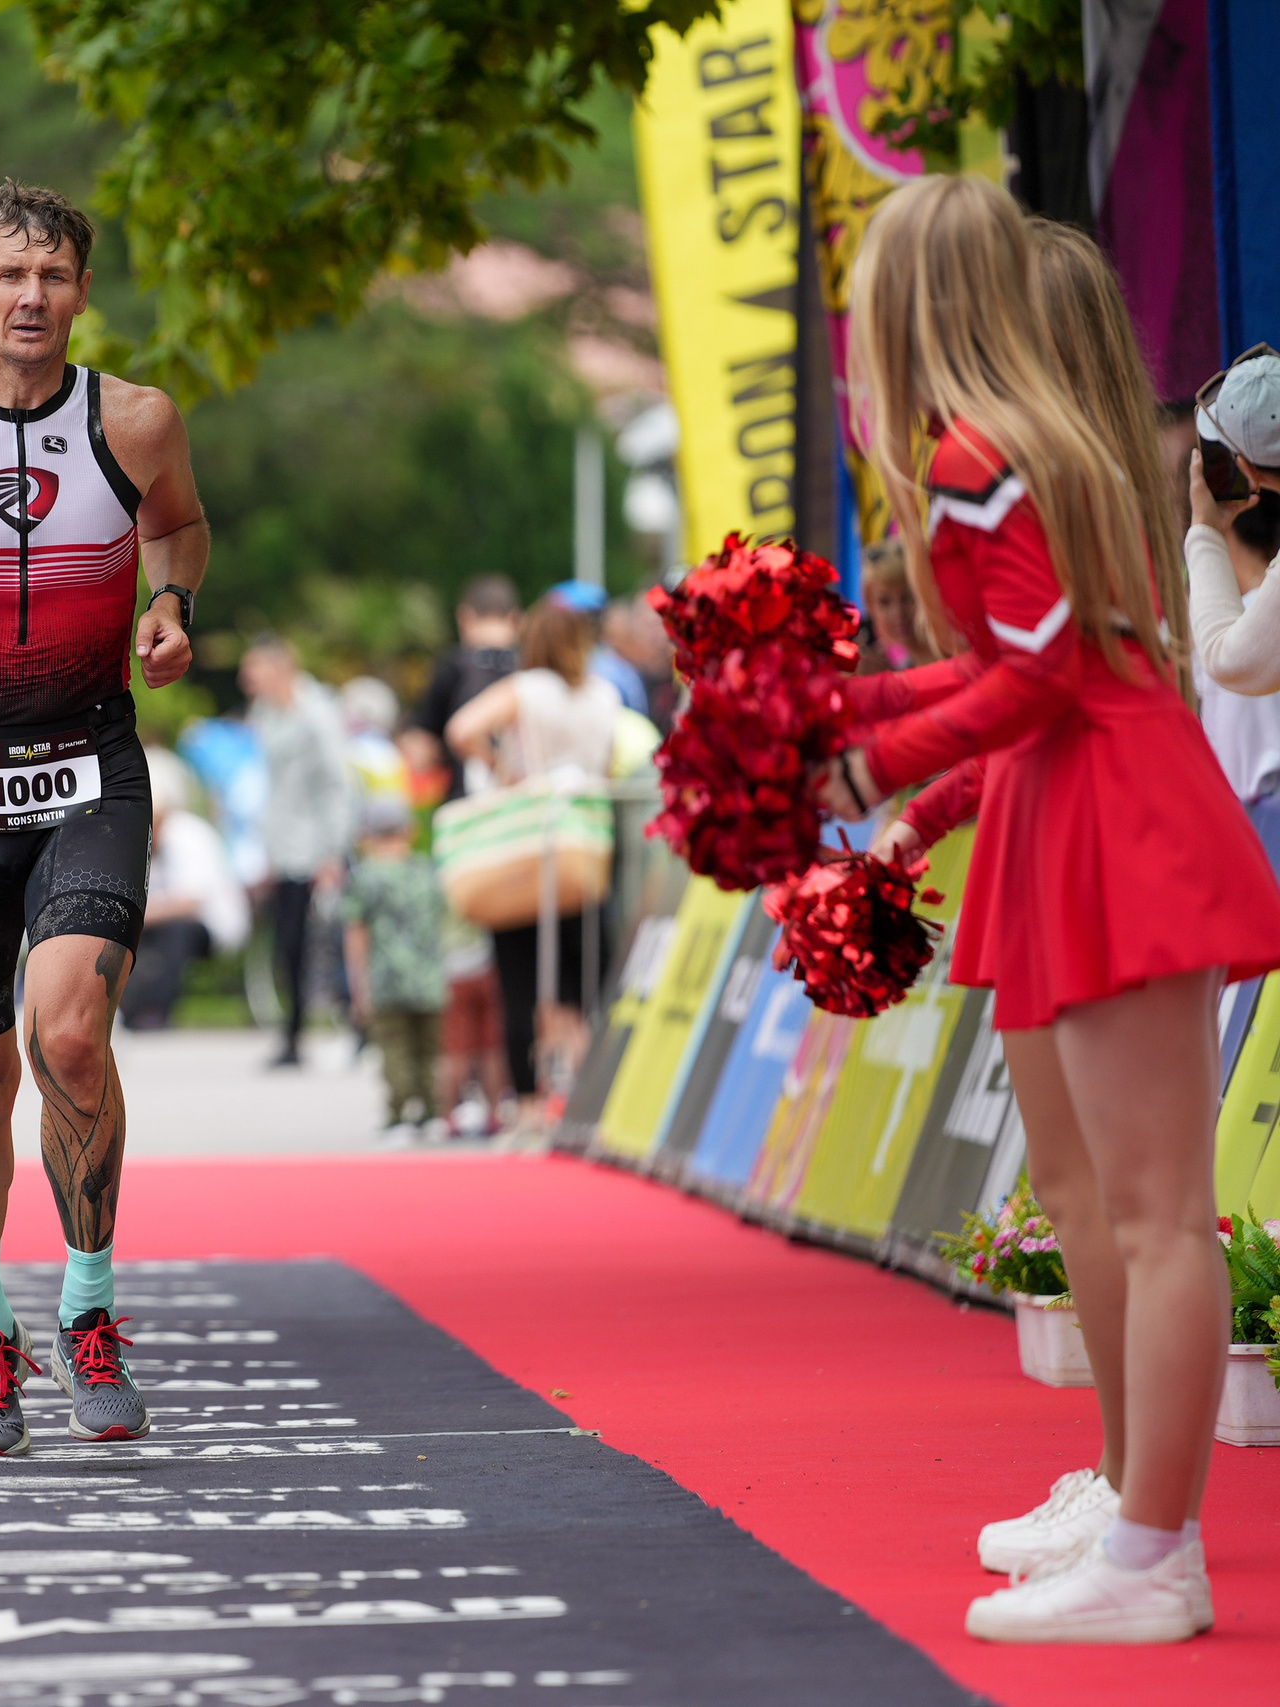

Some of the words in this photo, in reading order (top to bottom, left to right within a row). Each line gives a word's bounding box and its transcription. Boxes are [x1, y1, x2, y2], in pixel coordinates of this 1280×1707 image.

[697, 33, 788, 244] STAR
[8, 746, 26, 755] IRON
[33, 742, 51, 753] STAR
[65, 739, 88, 748] МАГНИТ
[7, 809, 65, 826] KONSTANTIN
[28, 1441, 382, 1457] STAR
[67, 1508, 466, 1526] STAR
[108, 1595, 568, 1625] STAR
